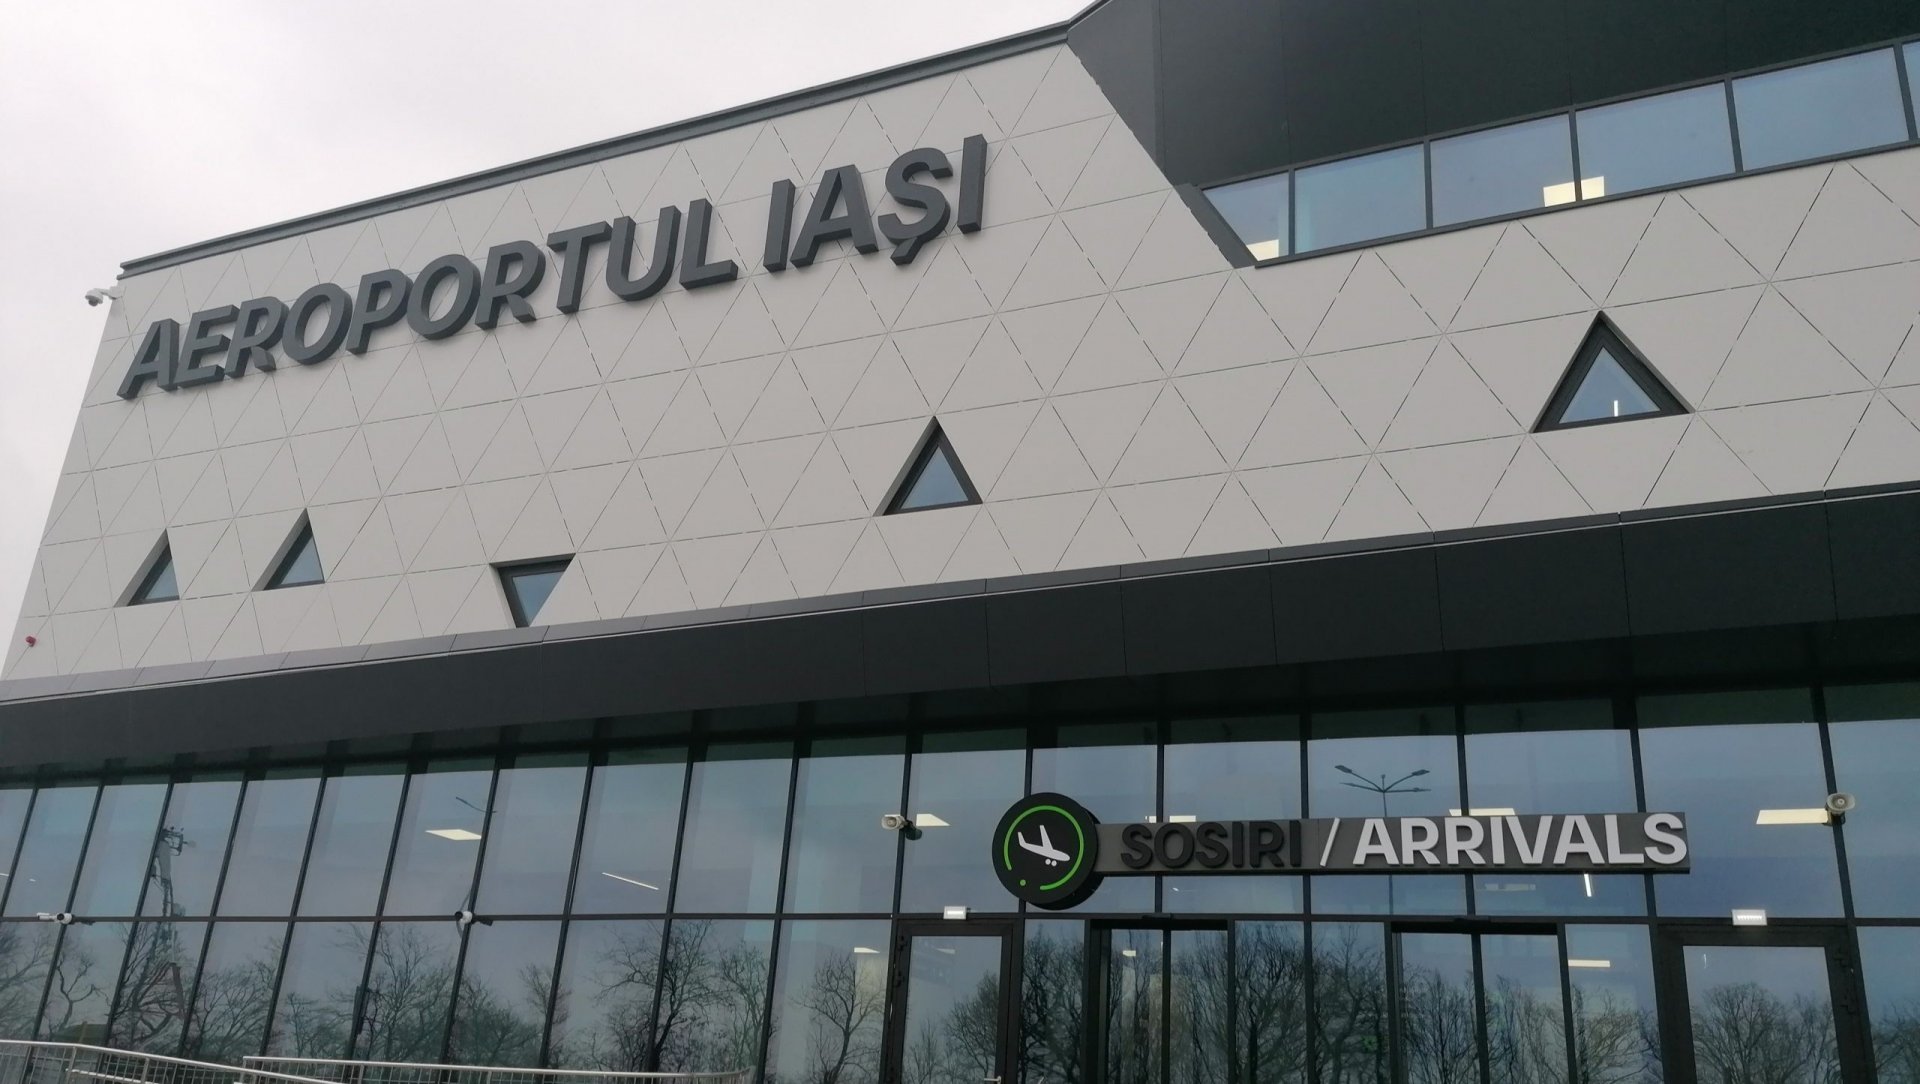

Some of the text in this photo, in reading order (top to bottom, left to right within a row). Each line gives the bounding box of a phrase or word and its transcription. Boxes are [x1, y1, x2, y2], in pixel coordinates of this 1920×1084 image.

[116, 198, 738, 401] AEROPORTUL
[1120, 820, 1302, 869] SOSIRI
[1352, 813, 1688, 866] ARRIVALS
